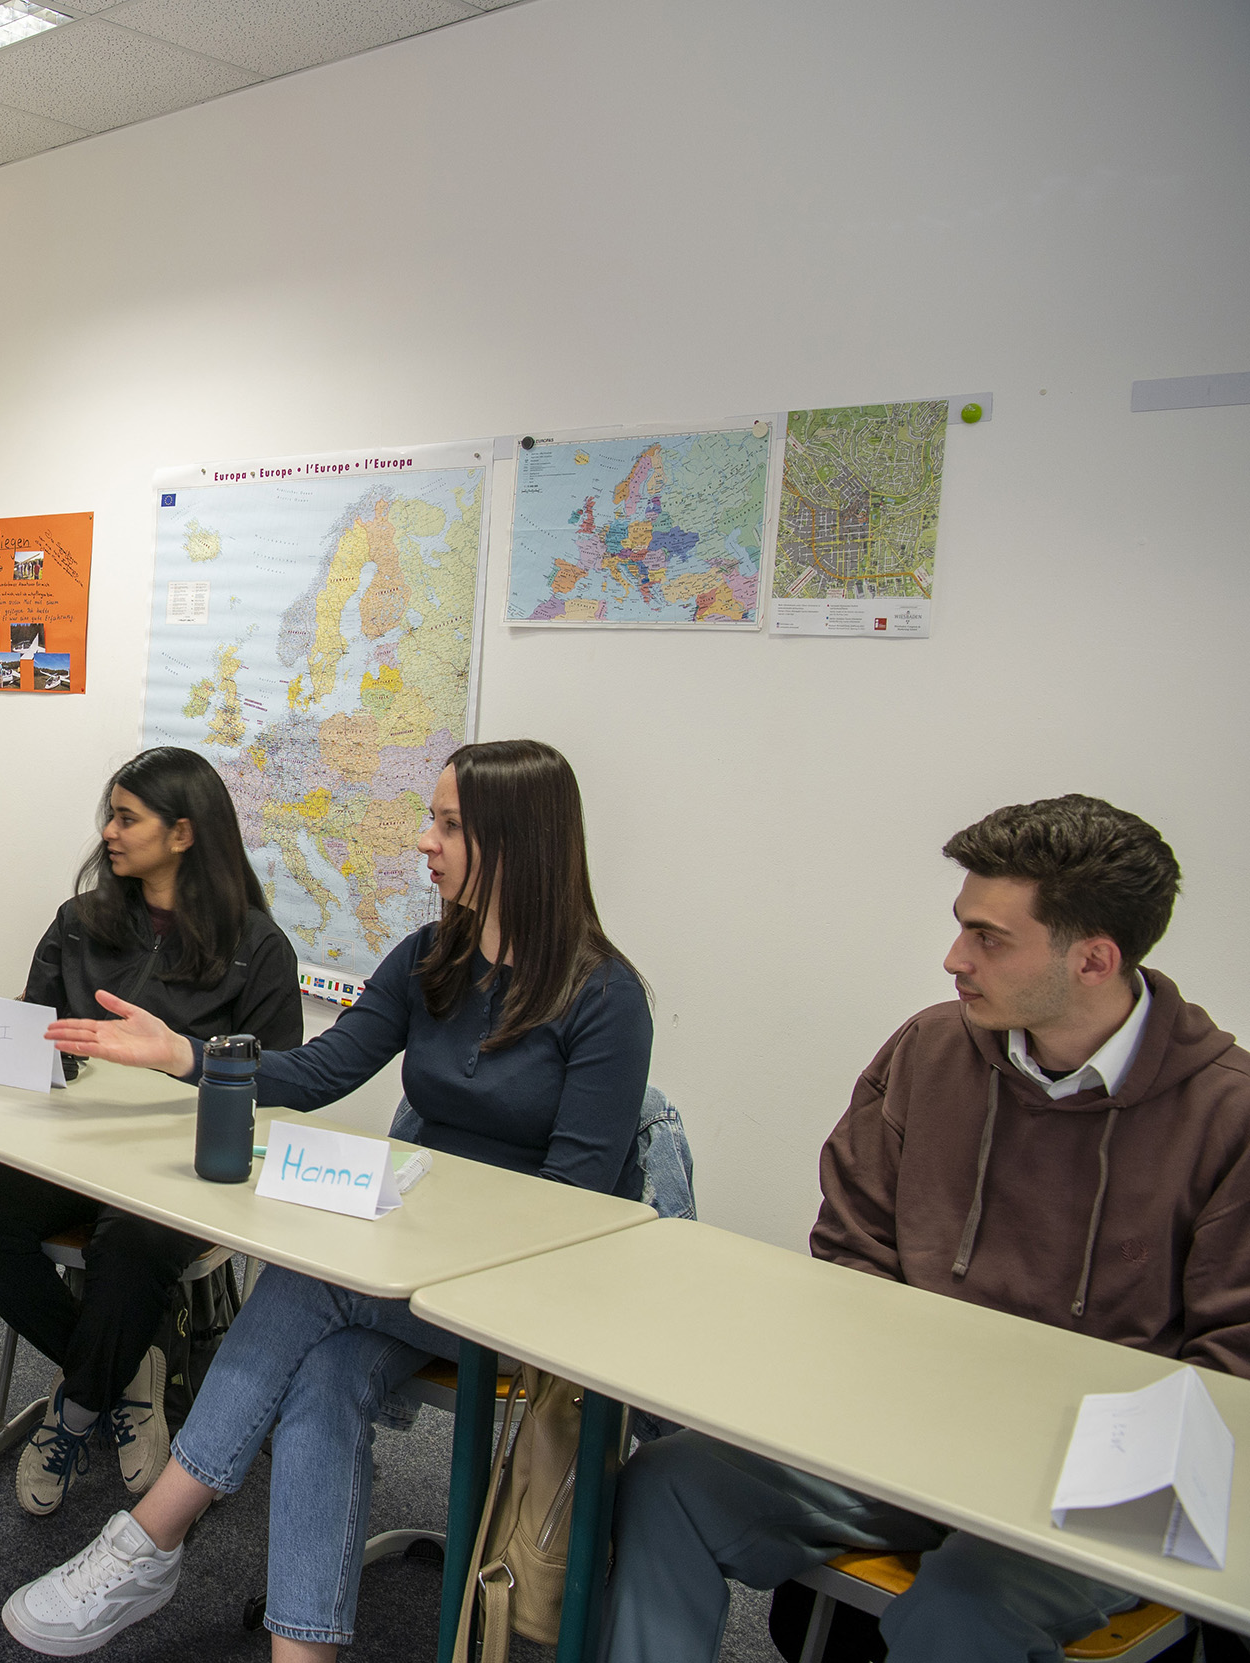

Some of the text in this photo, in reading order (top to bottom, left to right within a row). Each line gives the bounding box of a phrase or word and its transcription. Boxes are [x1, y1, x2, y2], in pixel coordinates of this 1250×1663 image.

[214, 471, 247, 483] Europa
[259, 467, 293, 479] Europe
[280, 1143, 374, 1190] Hanna
